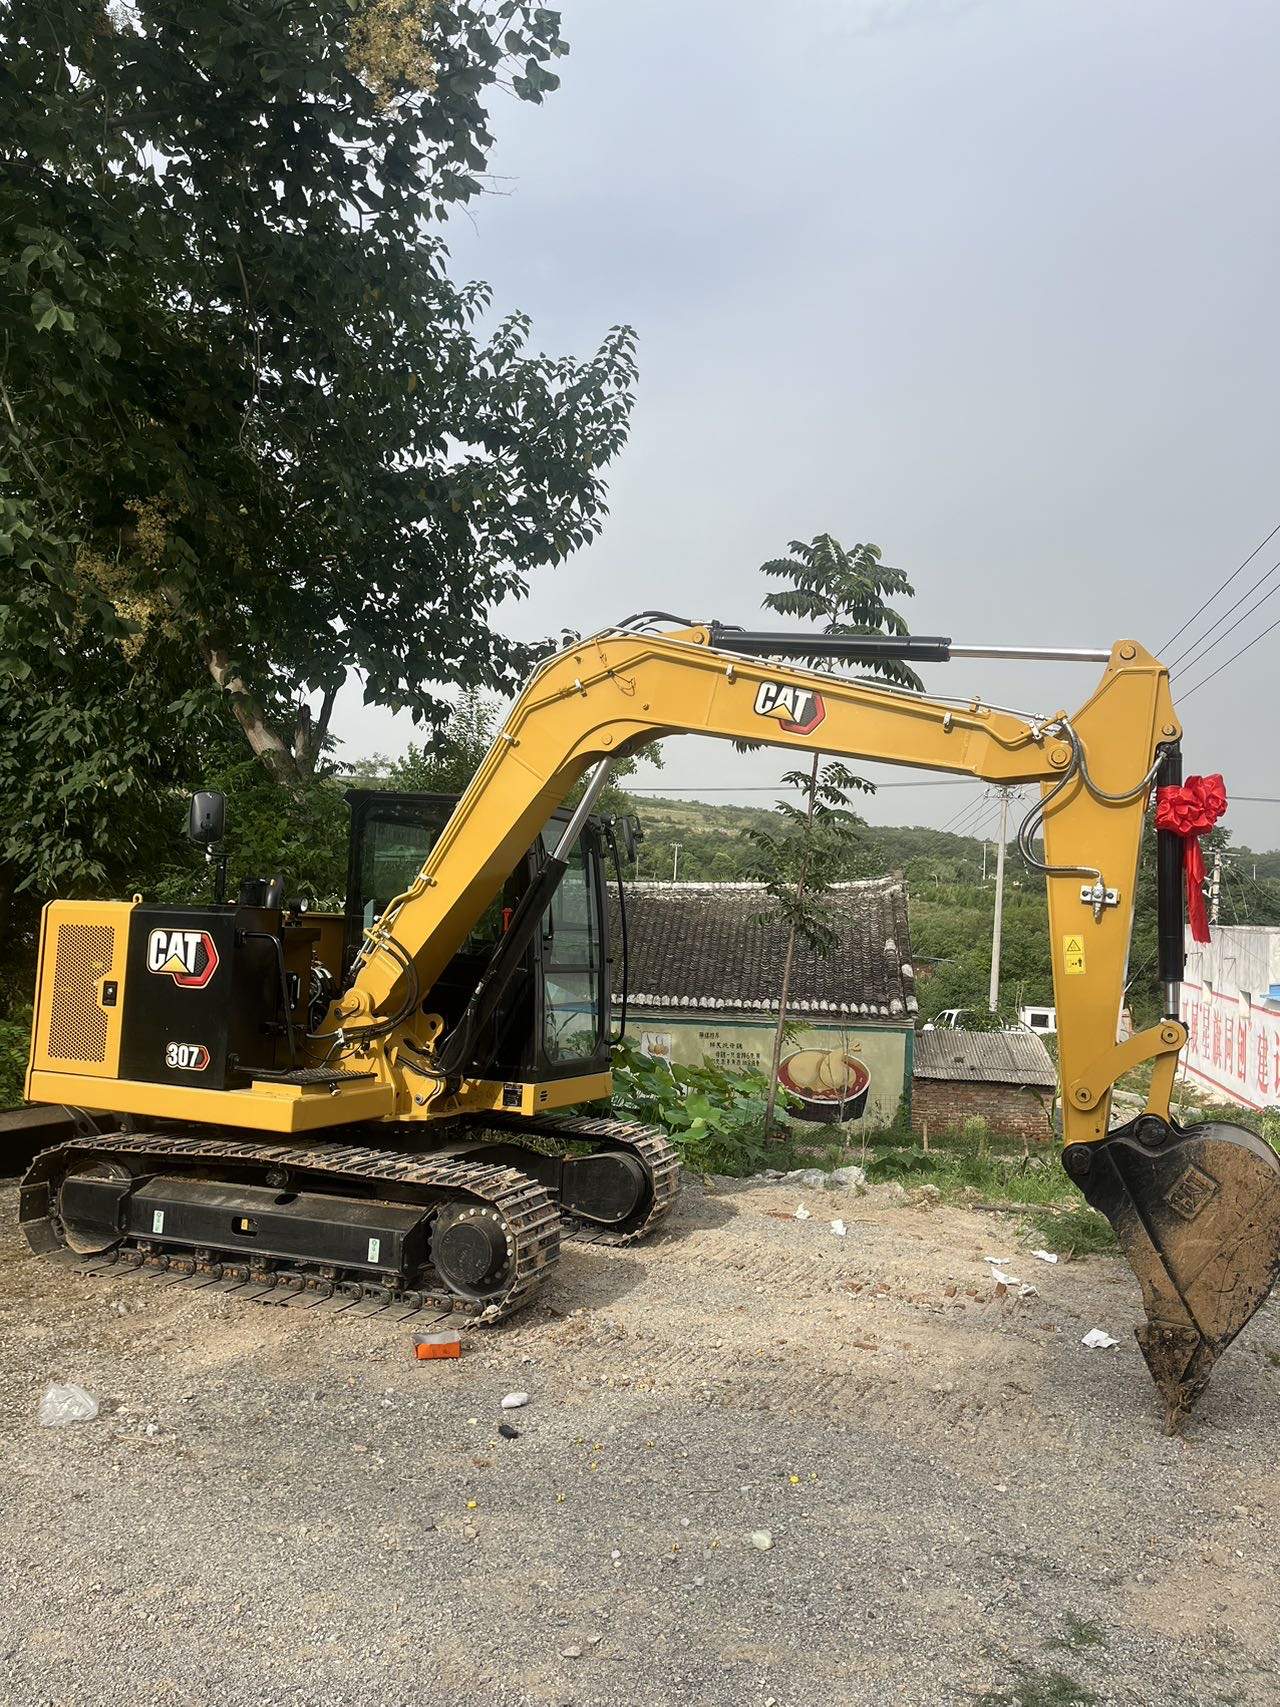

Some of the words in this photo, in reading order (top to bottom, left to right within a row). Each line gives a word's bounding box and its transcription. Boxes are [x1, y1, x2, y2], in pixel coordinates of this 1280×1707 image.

[754, 681, 813, 723] CAT
[150, 930, 202, 974] CAT
[167, 1043, 199, 1067] 307
